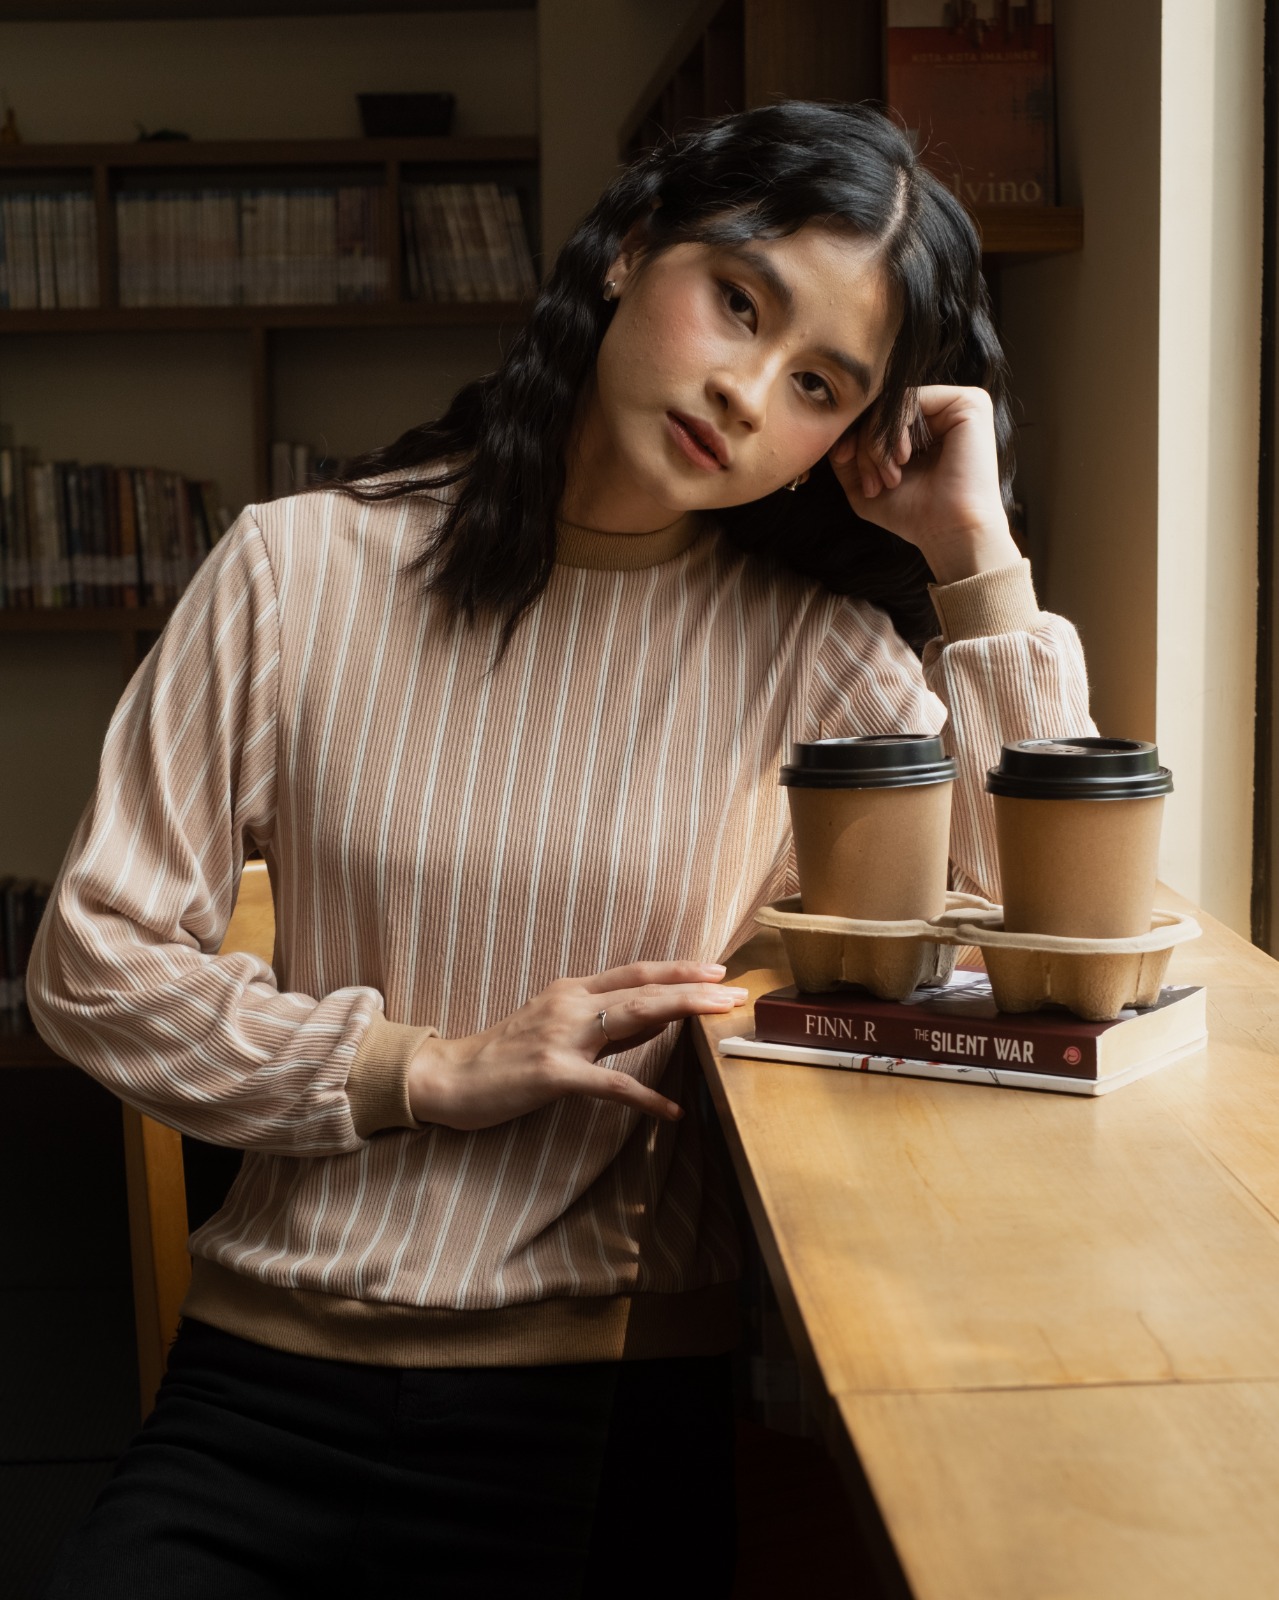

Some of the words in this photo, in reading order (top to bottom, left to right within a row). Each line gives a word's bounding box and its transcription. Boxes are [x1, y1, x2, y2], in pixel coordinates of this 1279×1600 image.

[952, 172, 1042, 203] lvino
[805, 1014, 858, 1040] FINN.
[864, 1020, 878, 1042] R
[913, 1028, 929, 1041] THE
[931, 1029, 988, 1057] SILENT
[993, 1037, 1035, 1064] WAR
